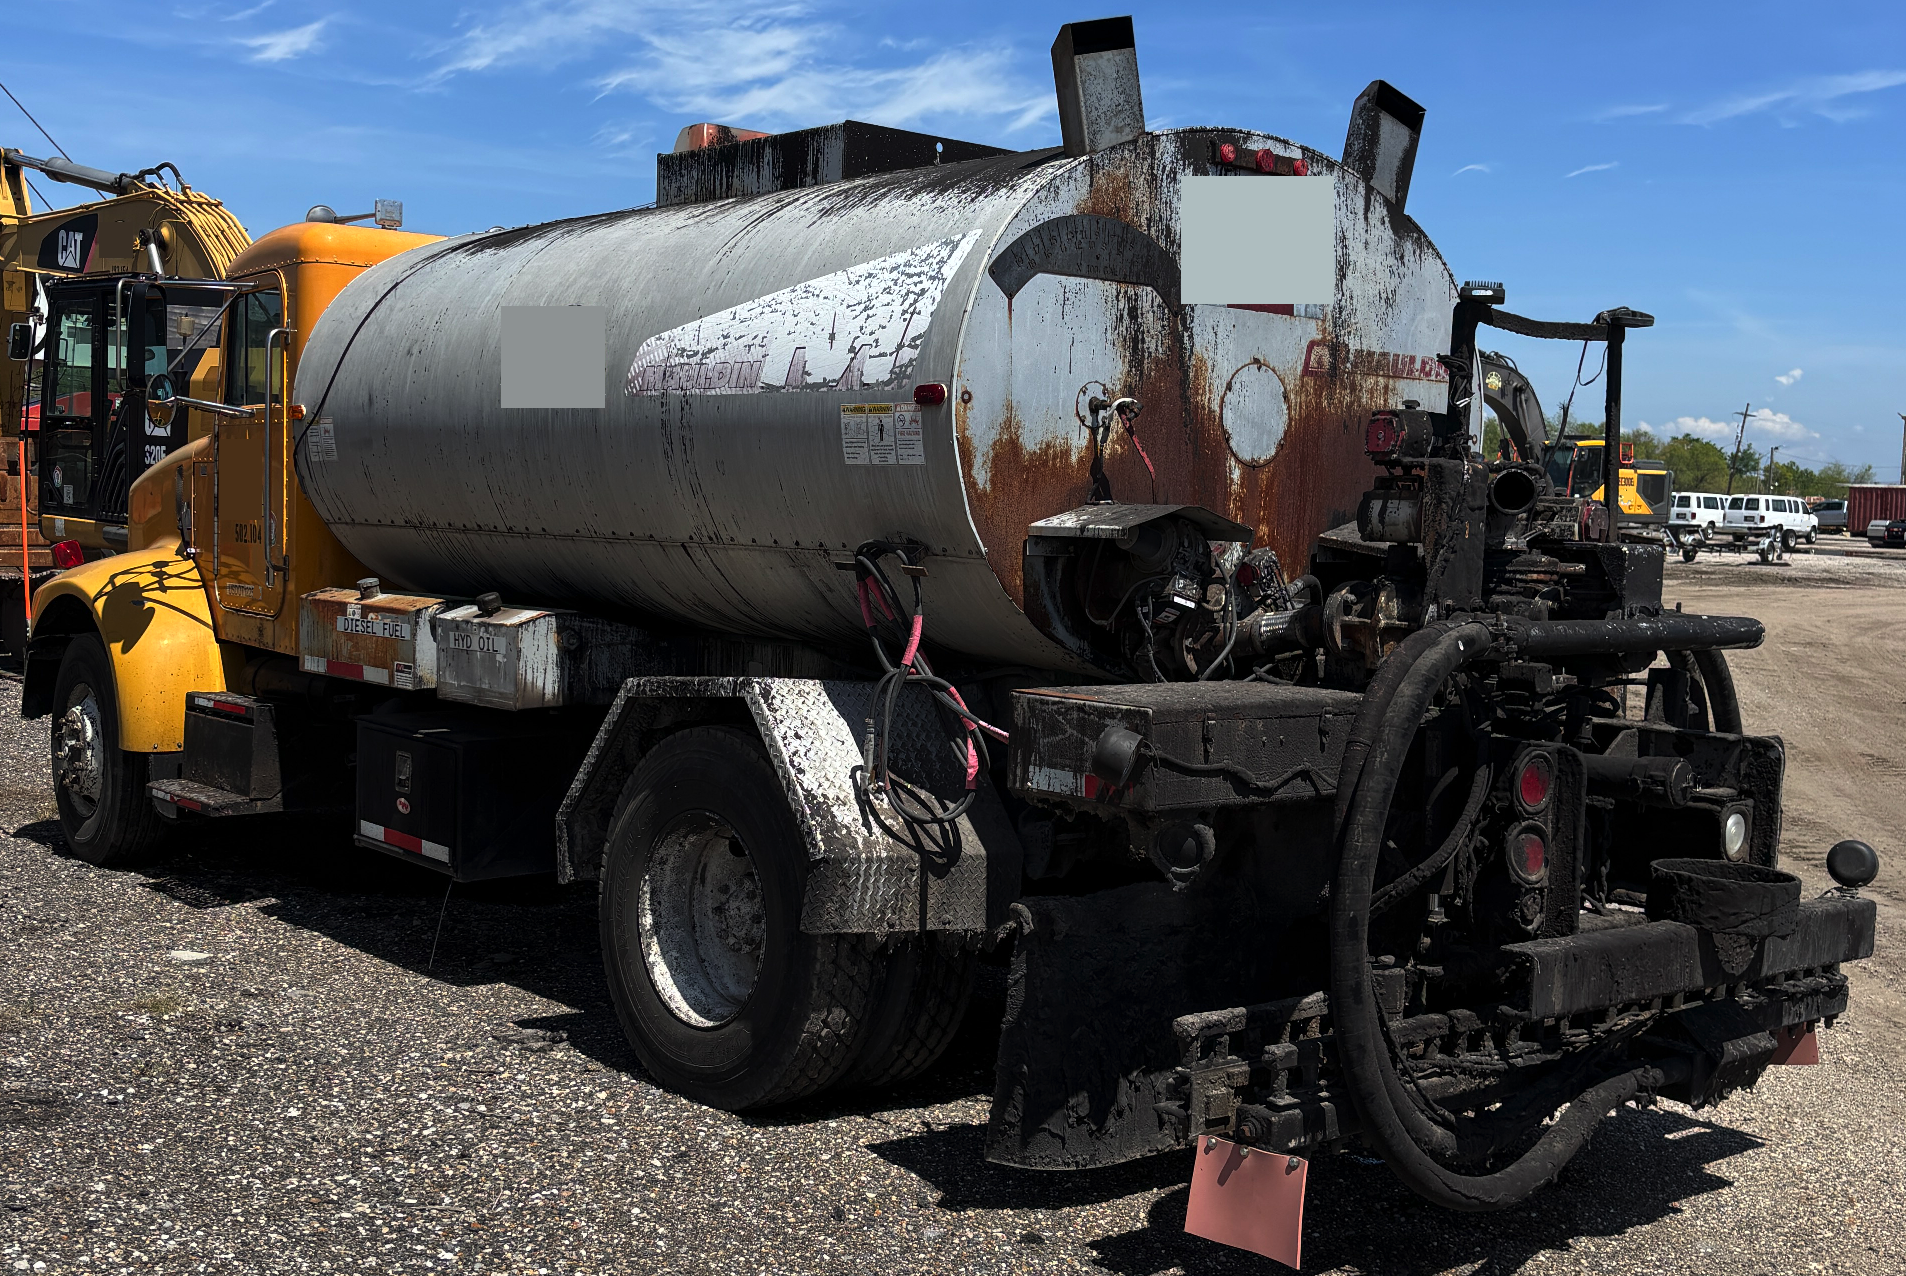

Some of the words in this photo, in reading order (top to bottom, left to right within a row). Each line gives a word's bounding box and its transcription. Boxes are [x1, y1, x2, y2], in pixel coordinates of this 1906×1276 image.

[58, 229, 83, 269] CAT
[638, 360, 763, 392] MAULDIN
[343, 617, 377, 635] DIESEL
[382, 622, 406, 639] FUEL
[453, 632, 472, 649] HYD
[478, 636, 499, 652] OIL
